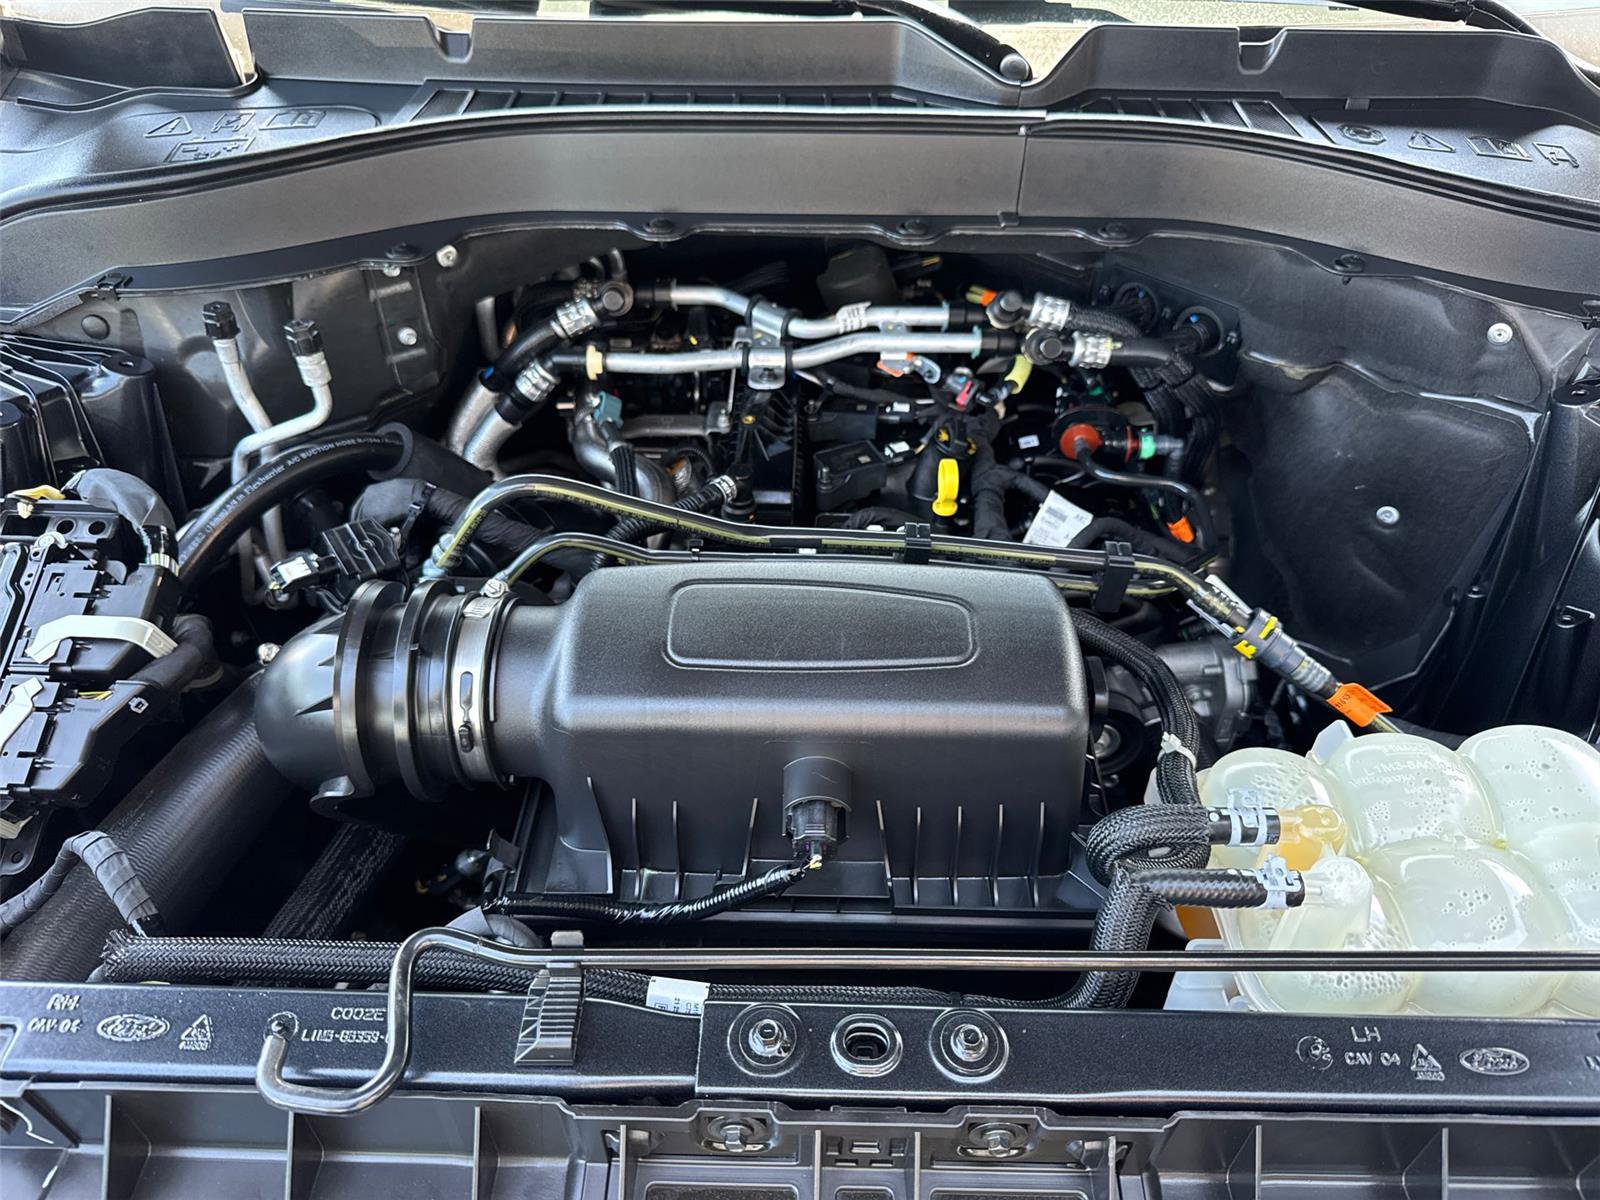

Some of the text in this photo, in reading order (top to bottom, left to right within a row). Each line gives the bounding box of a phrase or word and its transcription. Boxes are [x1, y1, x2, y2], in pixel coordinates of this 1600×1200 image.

[287, 456, 300, 467] A/C
[300, 443, 336, 460] SUCTION
[335, 438, 357, 448] HOSE
[1350, 1026, 1381, 1043] LH
[1344, 1051, 1373, 1066] CAV
